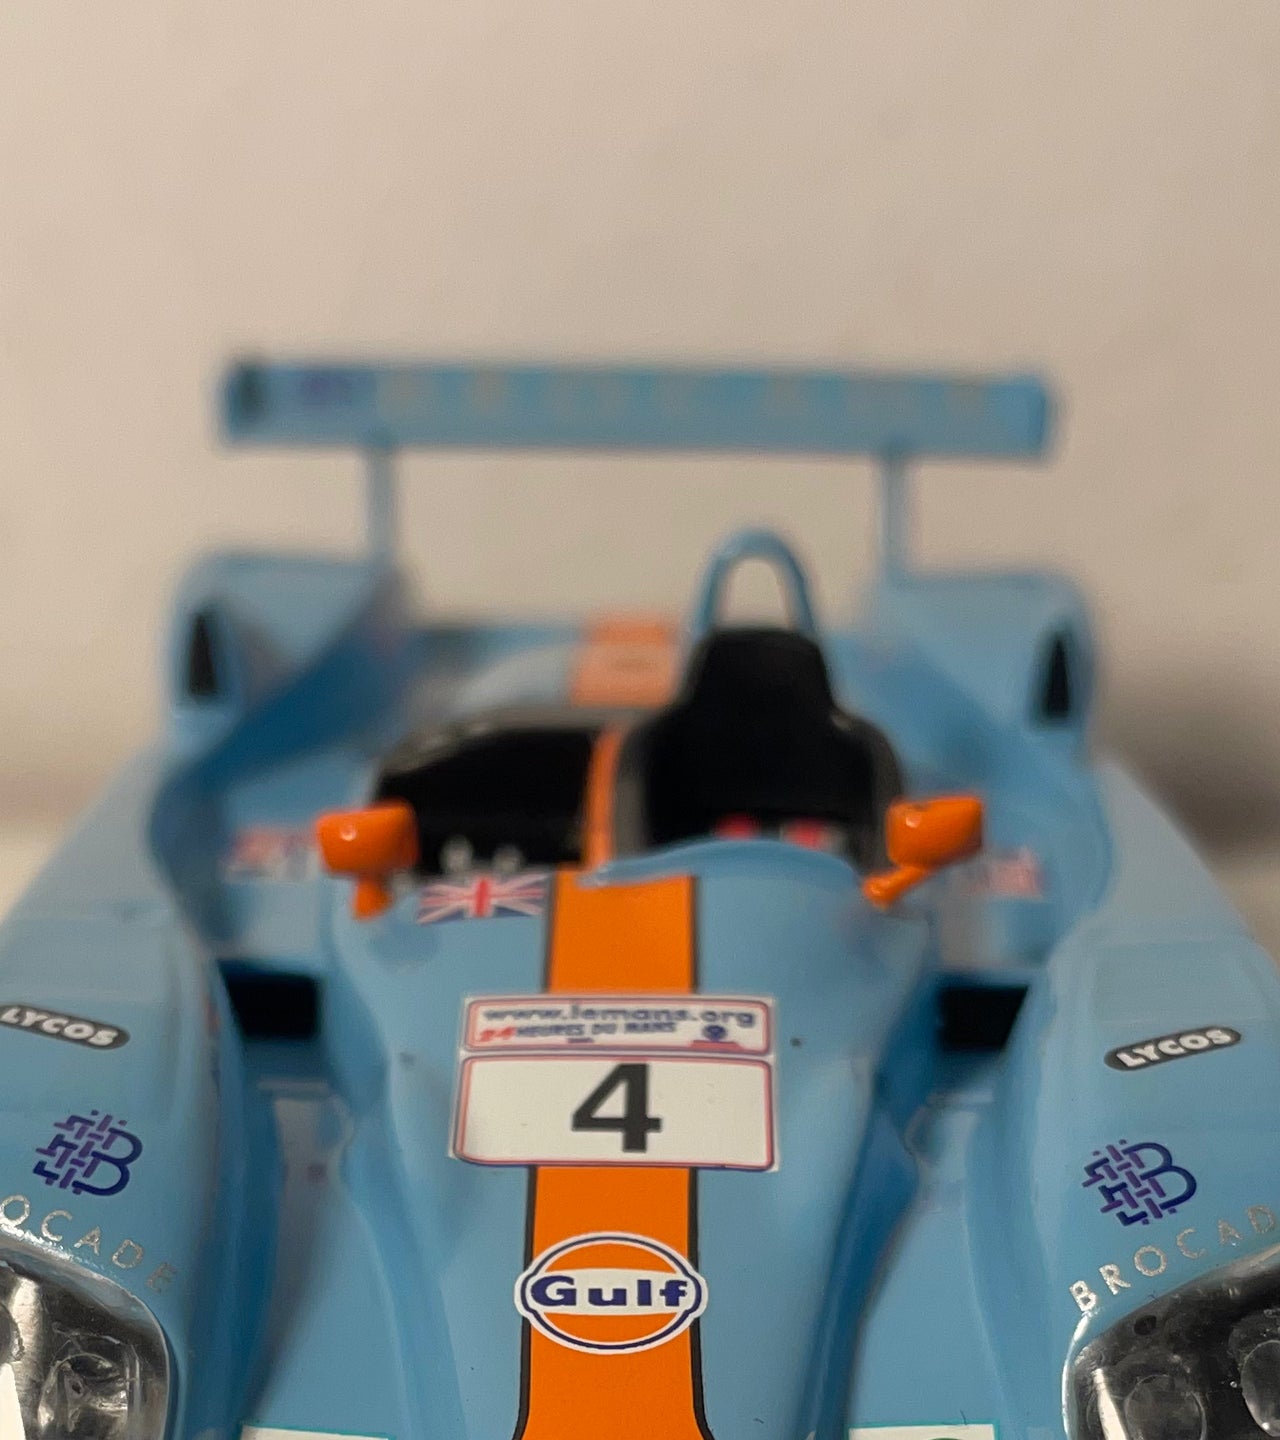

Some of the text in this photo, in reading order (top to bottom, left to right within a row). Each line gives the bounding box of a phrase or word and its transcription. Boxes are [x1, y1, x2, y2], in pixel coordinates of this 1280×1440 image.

[1116, 1027, 1233, 1068] LYCOS
[571, 1062, 662, 1153] 4
[530, 1275, 688, 1307] Gulf
